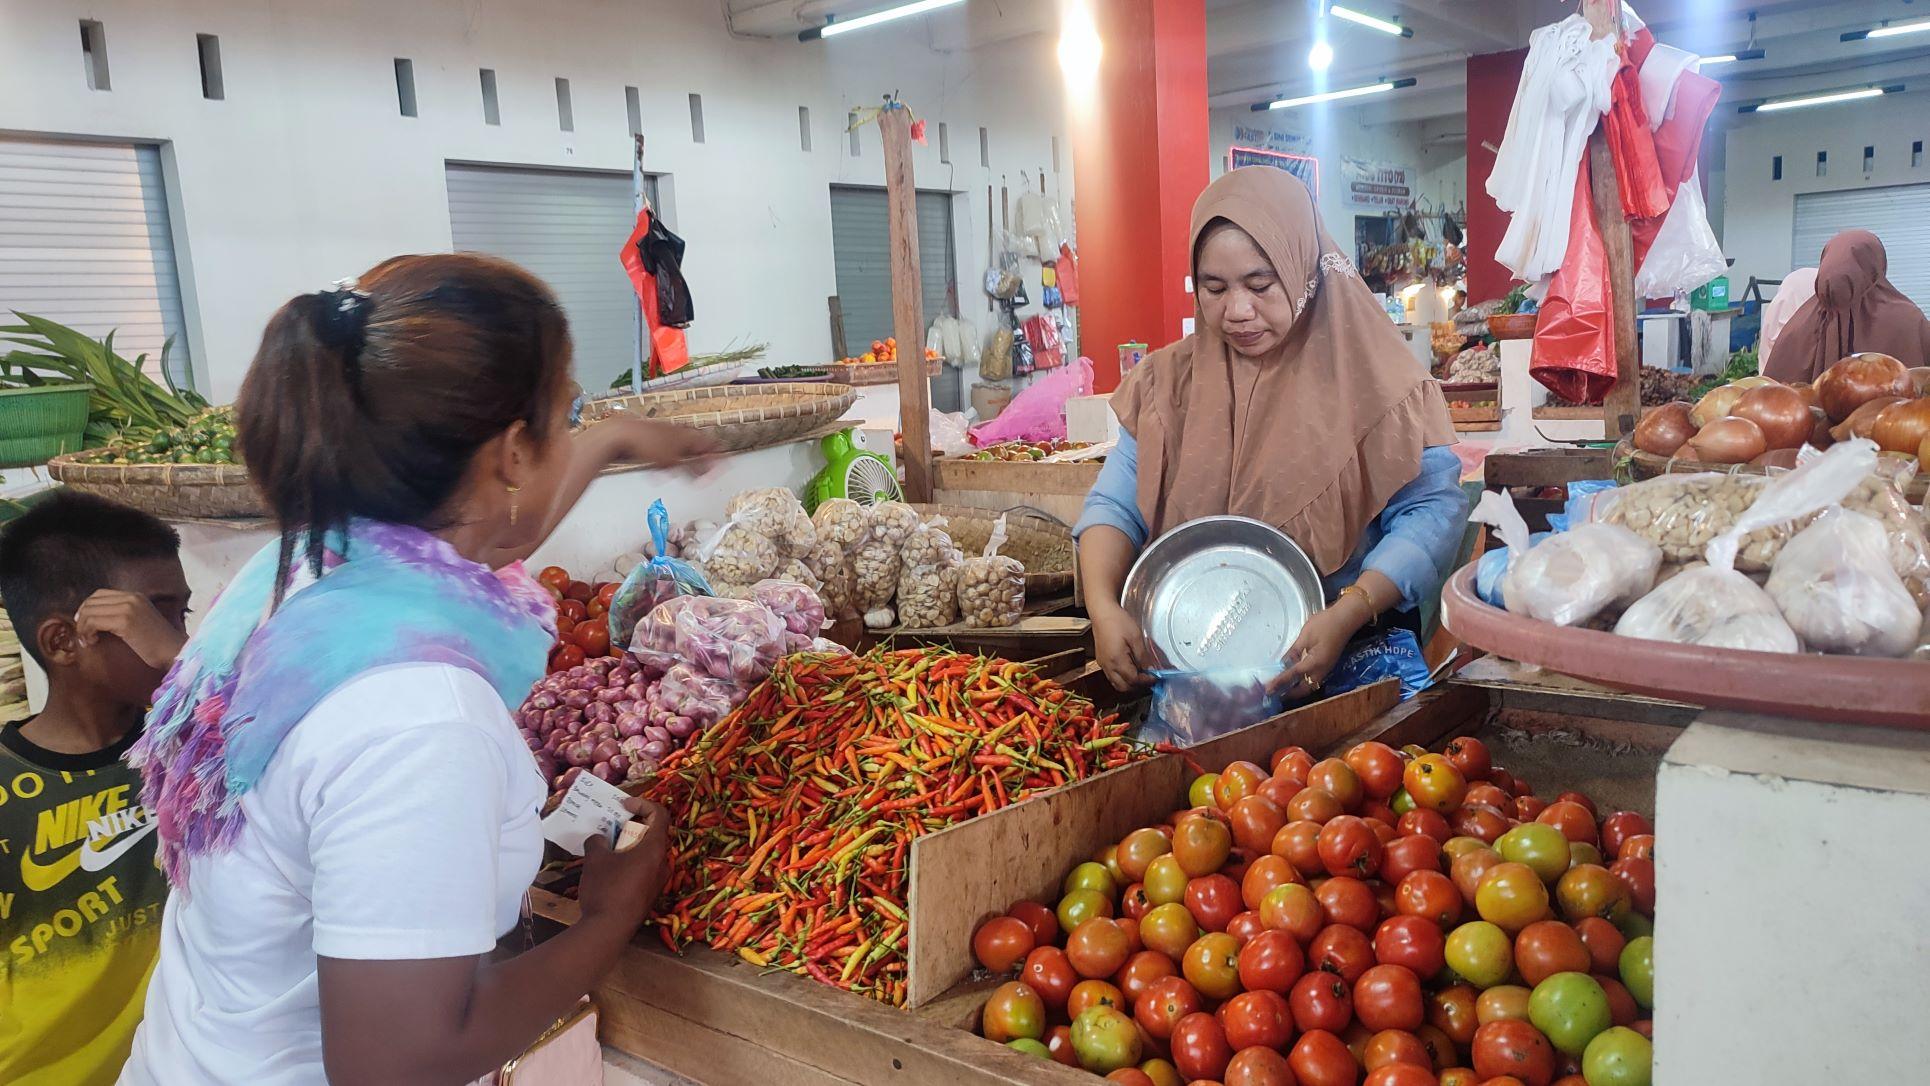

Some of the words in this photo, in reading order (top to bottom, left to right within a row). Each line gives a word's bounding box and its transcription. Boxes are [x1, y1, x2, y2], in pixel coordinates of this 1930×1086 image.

[34, 783, 131, 856] NIKE
[10, 875, 124, 965] SPORT
[106, 902, 160, 938] JUST
